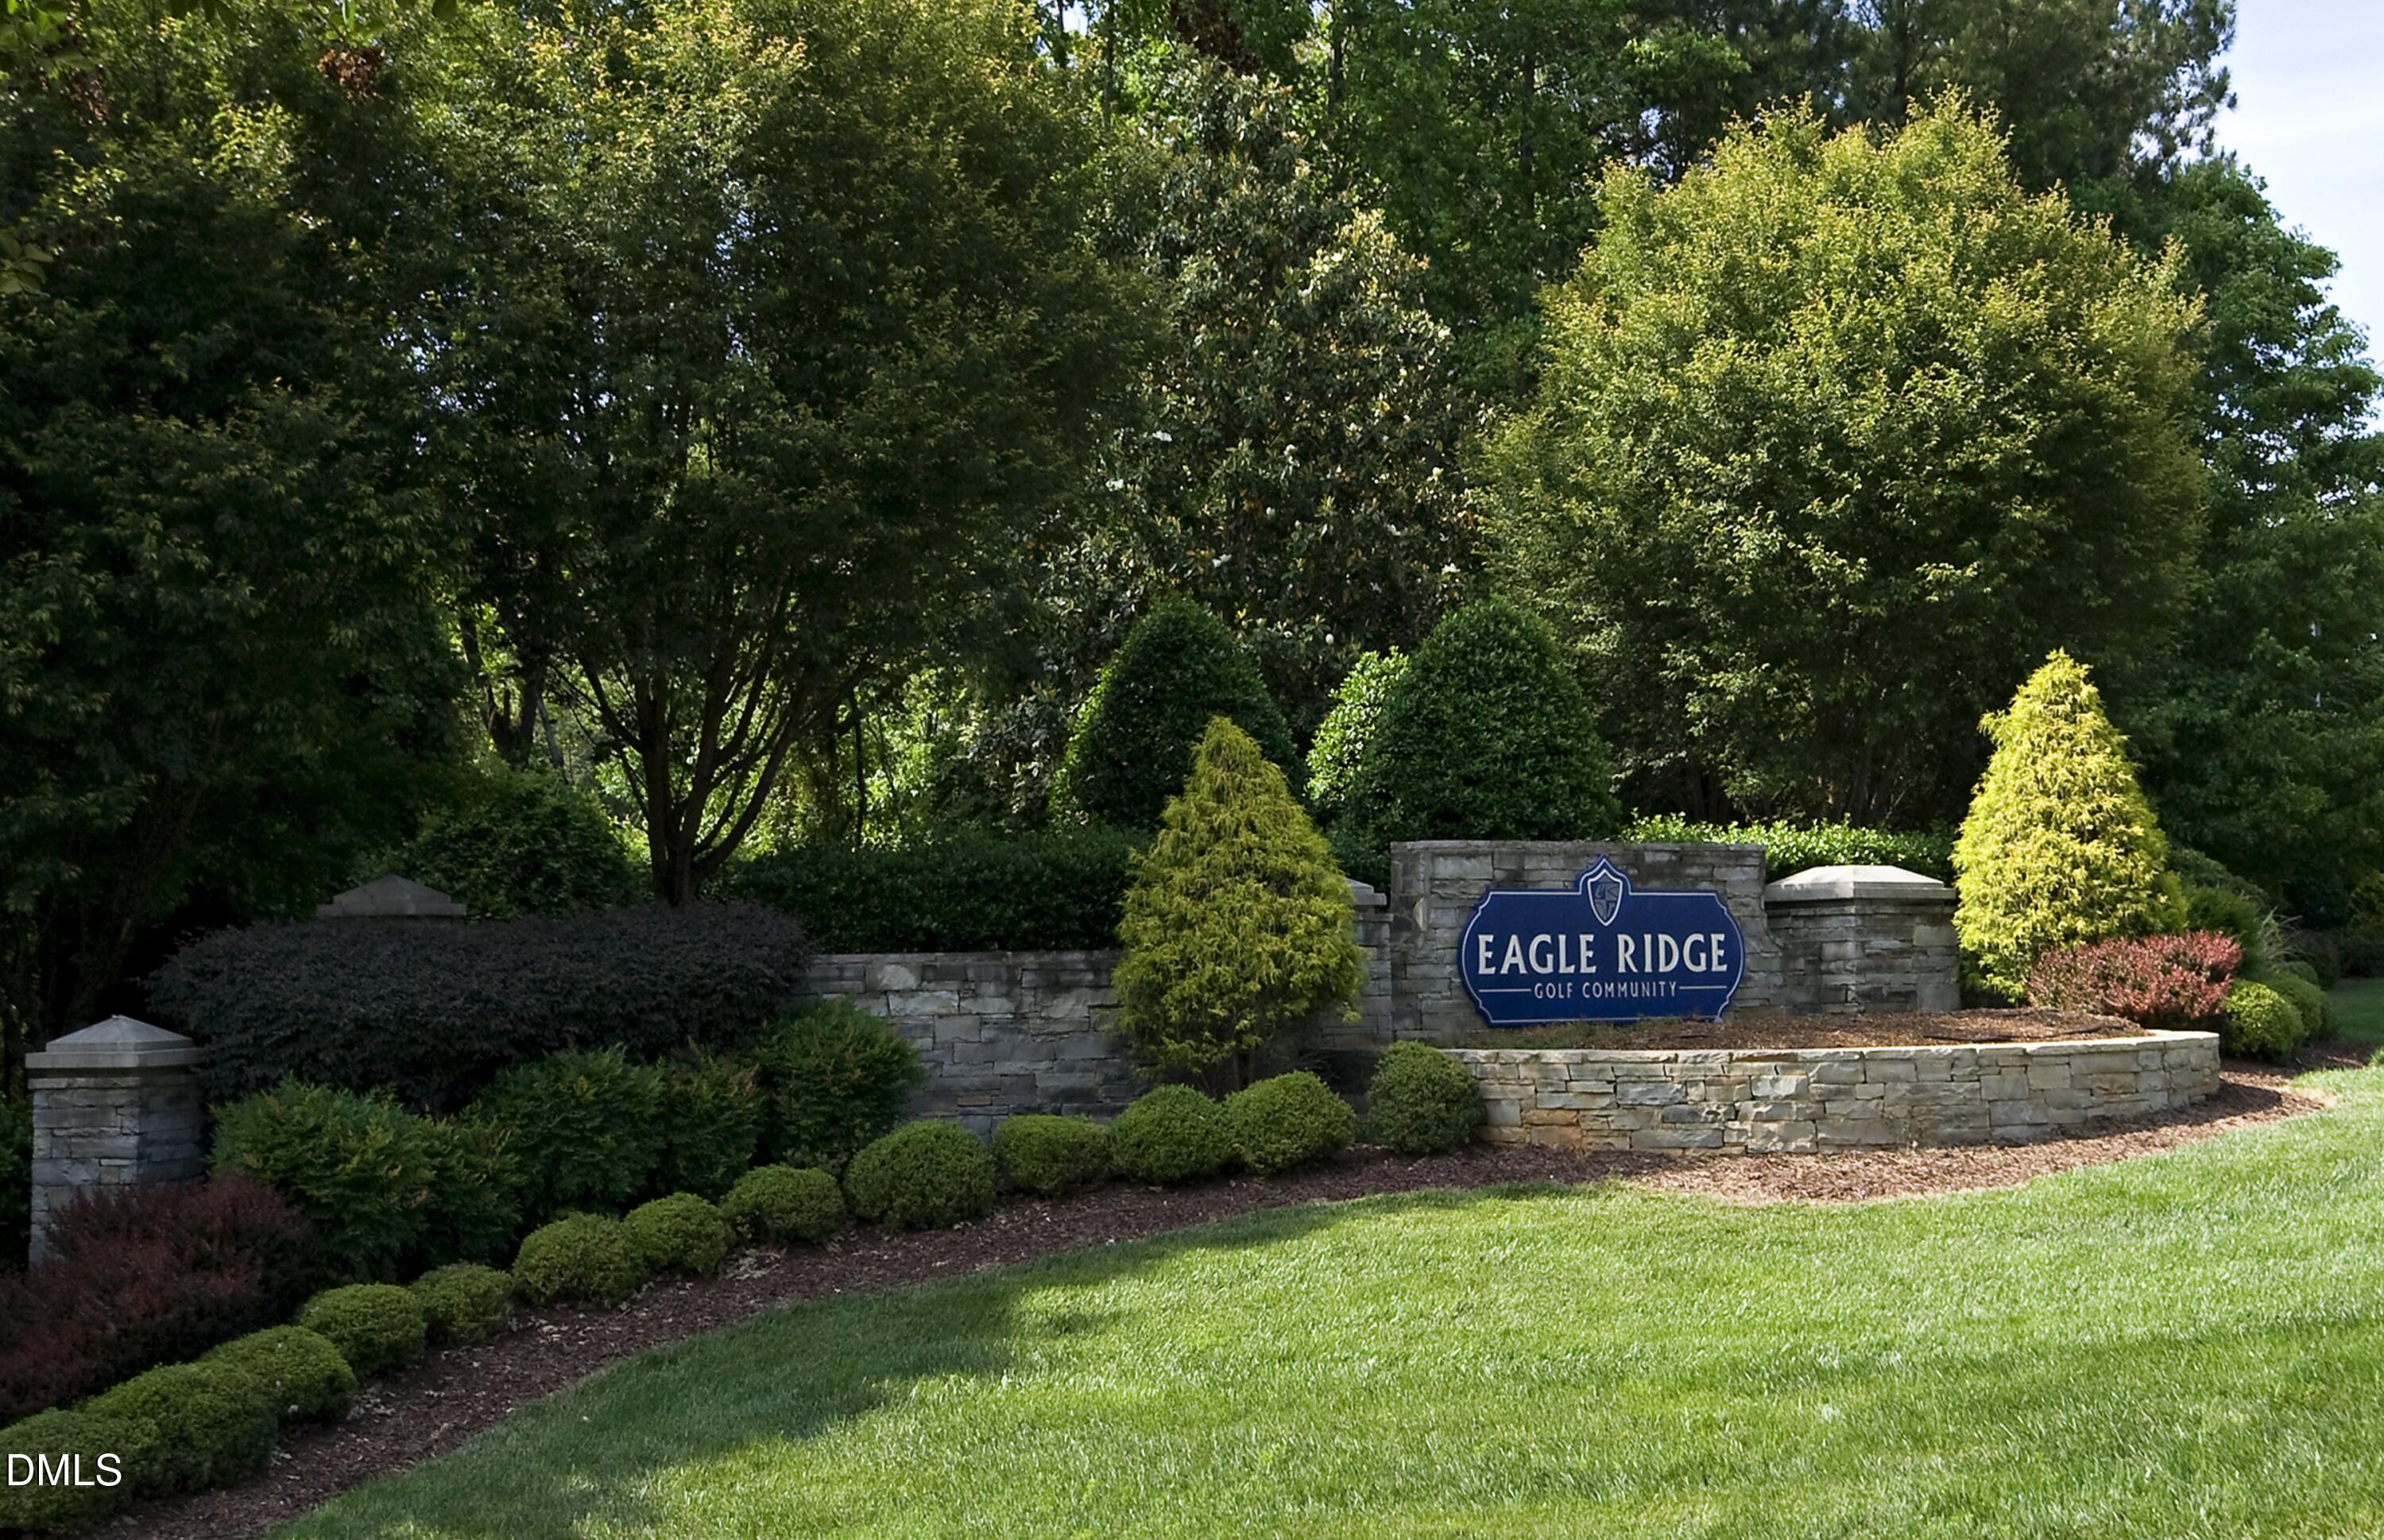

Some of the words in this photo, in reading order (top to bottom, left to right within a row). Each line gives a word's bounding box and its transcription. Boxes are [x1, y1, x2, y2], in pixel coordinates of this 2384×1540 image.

[1478, 934, 1596, 974] EAGLE
[1618, 933, 1728, 973] RIDGE
[1535, 982, 1573, 999] GOLF
[1582, 981, 1678, 998] COMMUNITY
